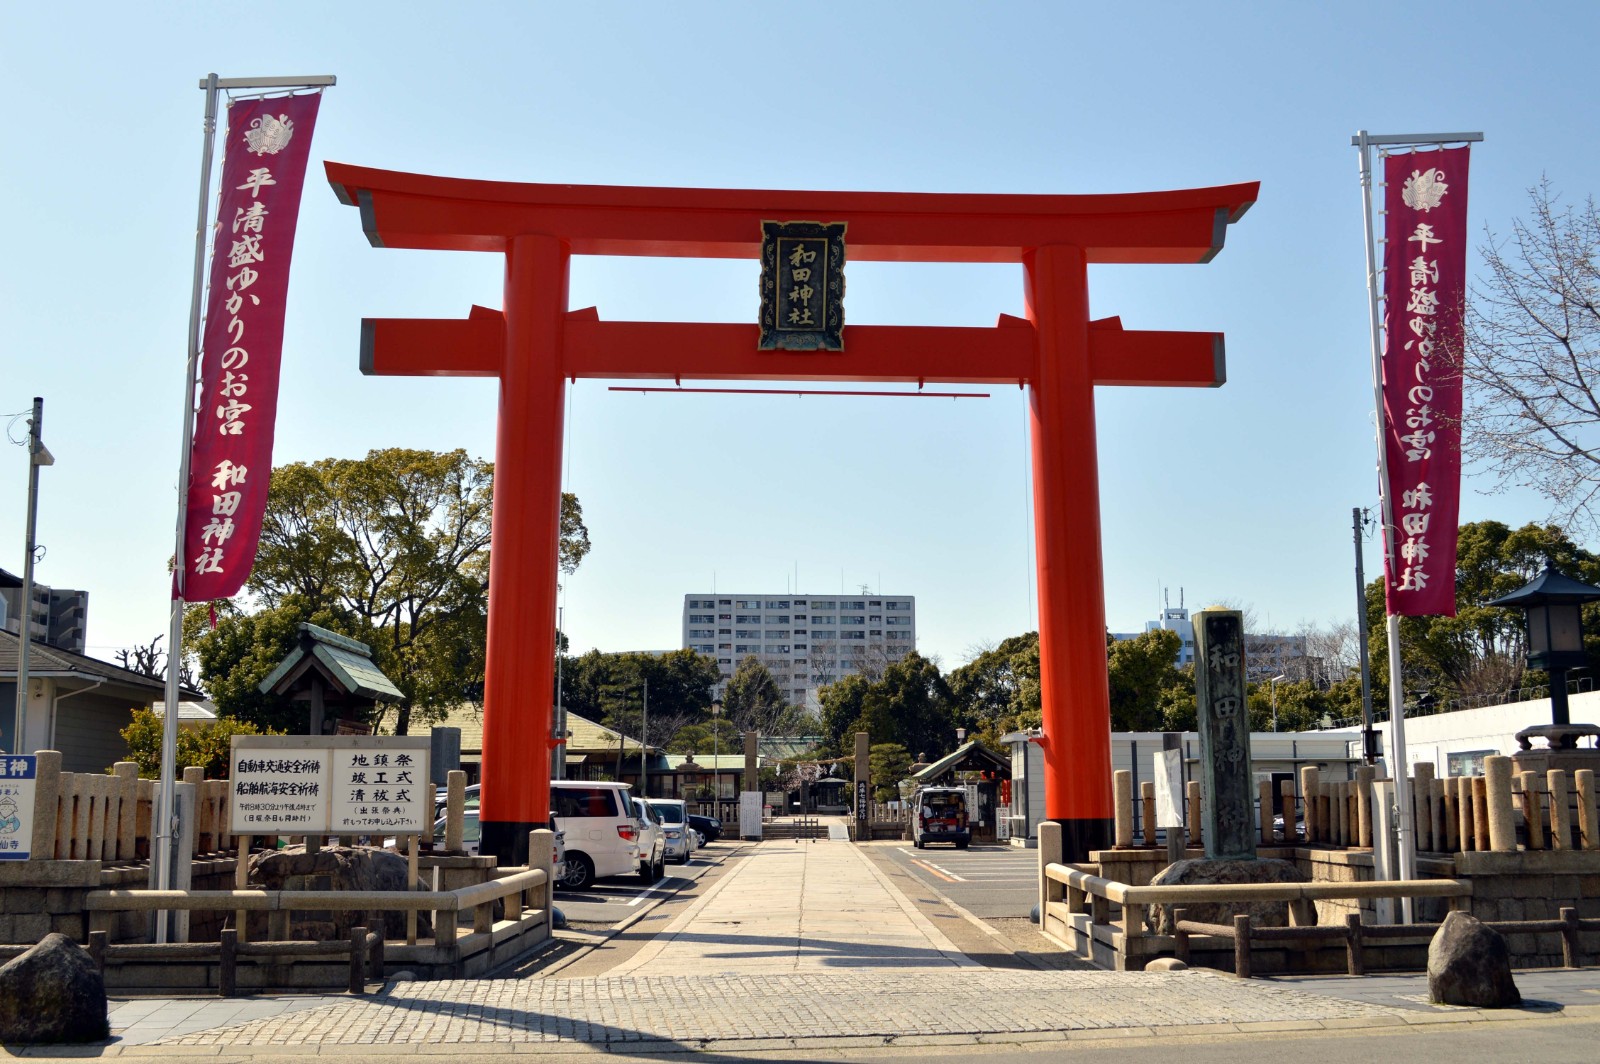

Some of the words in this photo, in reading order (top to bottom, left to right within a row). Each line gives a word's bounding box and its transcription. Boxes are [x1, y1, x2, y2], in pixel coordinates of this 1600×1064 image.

[787, 243, 817, 325] 和田神社
[216, 167, 276, 436] 平清盛ゆかりのお宮
[194, 459, 248, 575] 和田神社
[1209, 643, 1249, 836] 和田神社
[237, 759, 321, 774] 自動車交通安全祈祷
[351, 753, 413, 767] 地鎮祭
[350, 770, 413, 784] 竣工式
[235, 781, 320, 797] 船舶航海安全祈祷
[350, 788, 412, 802] 清祓式
